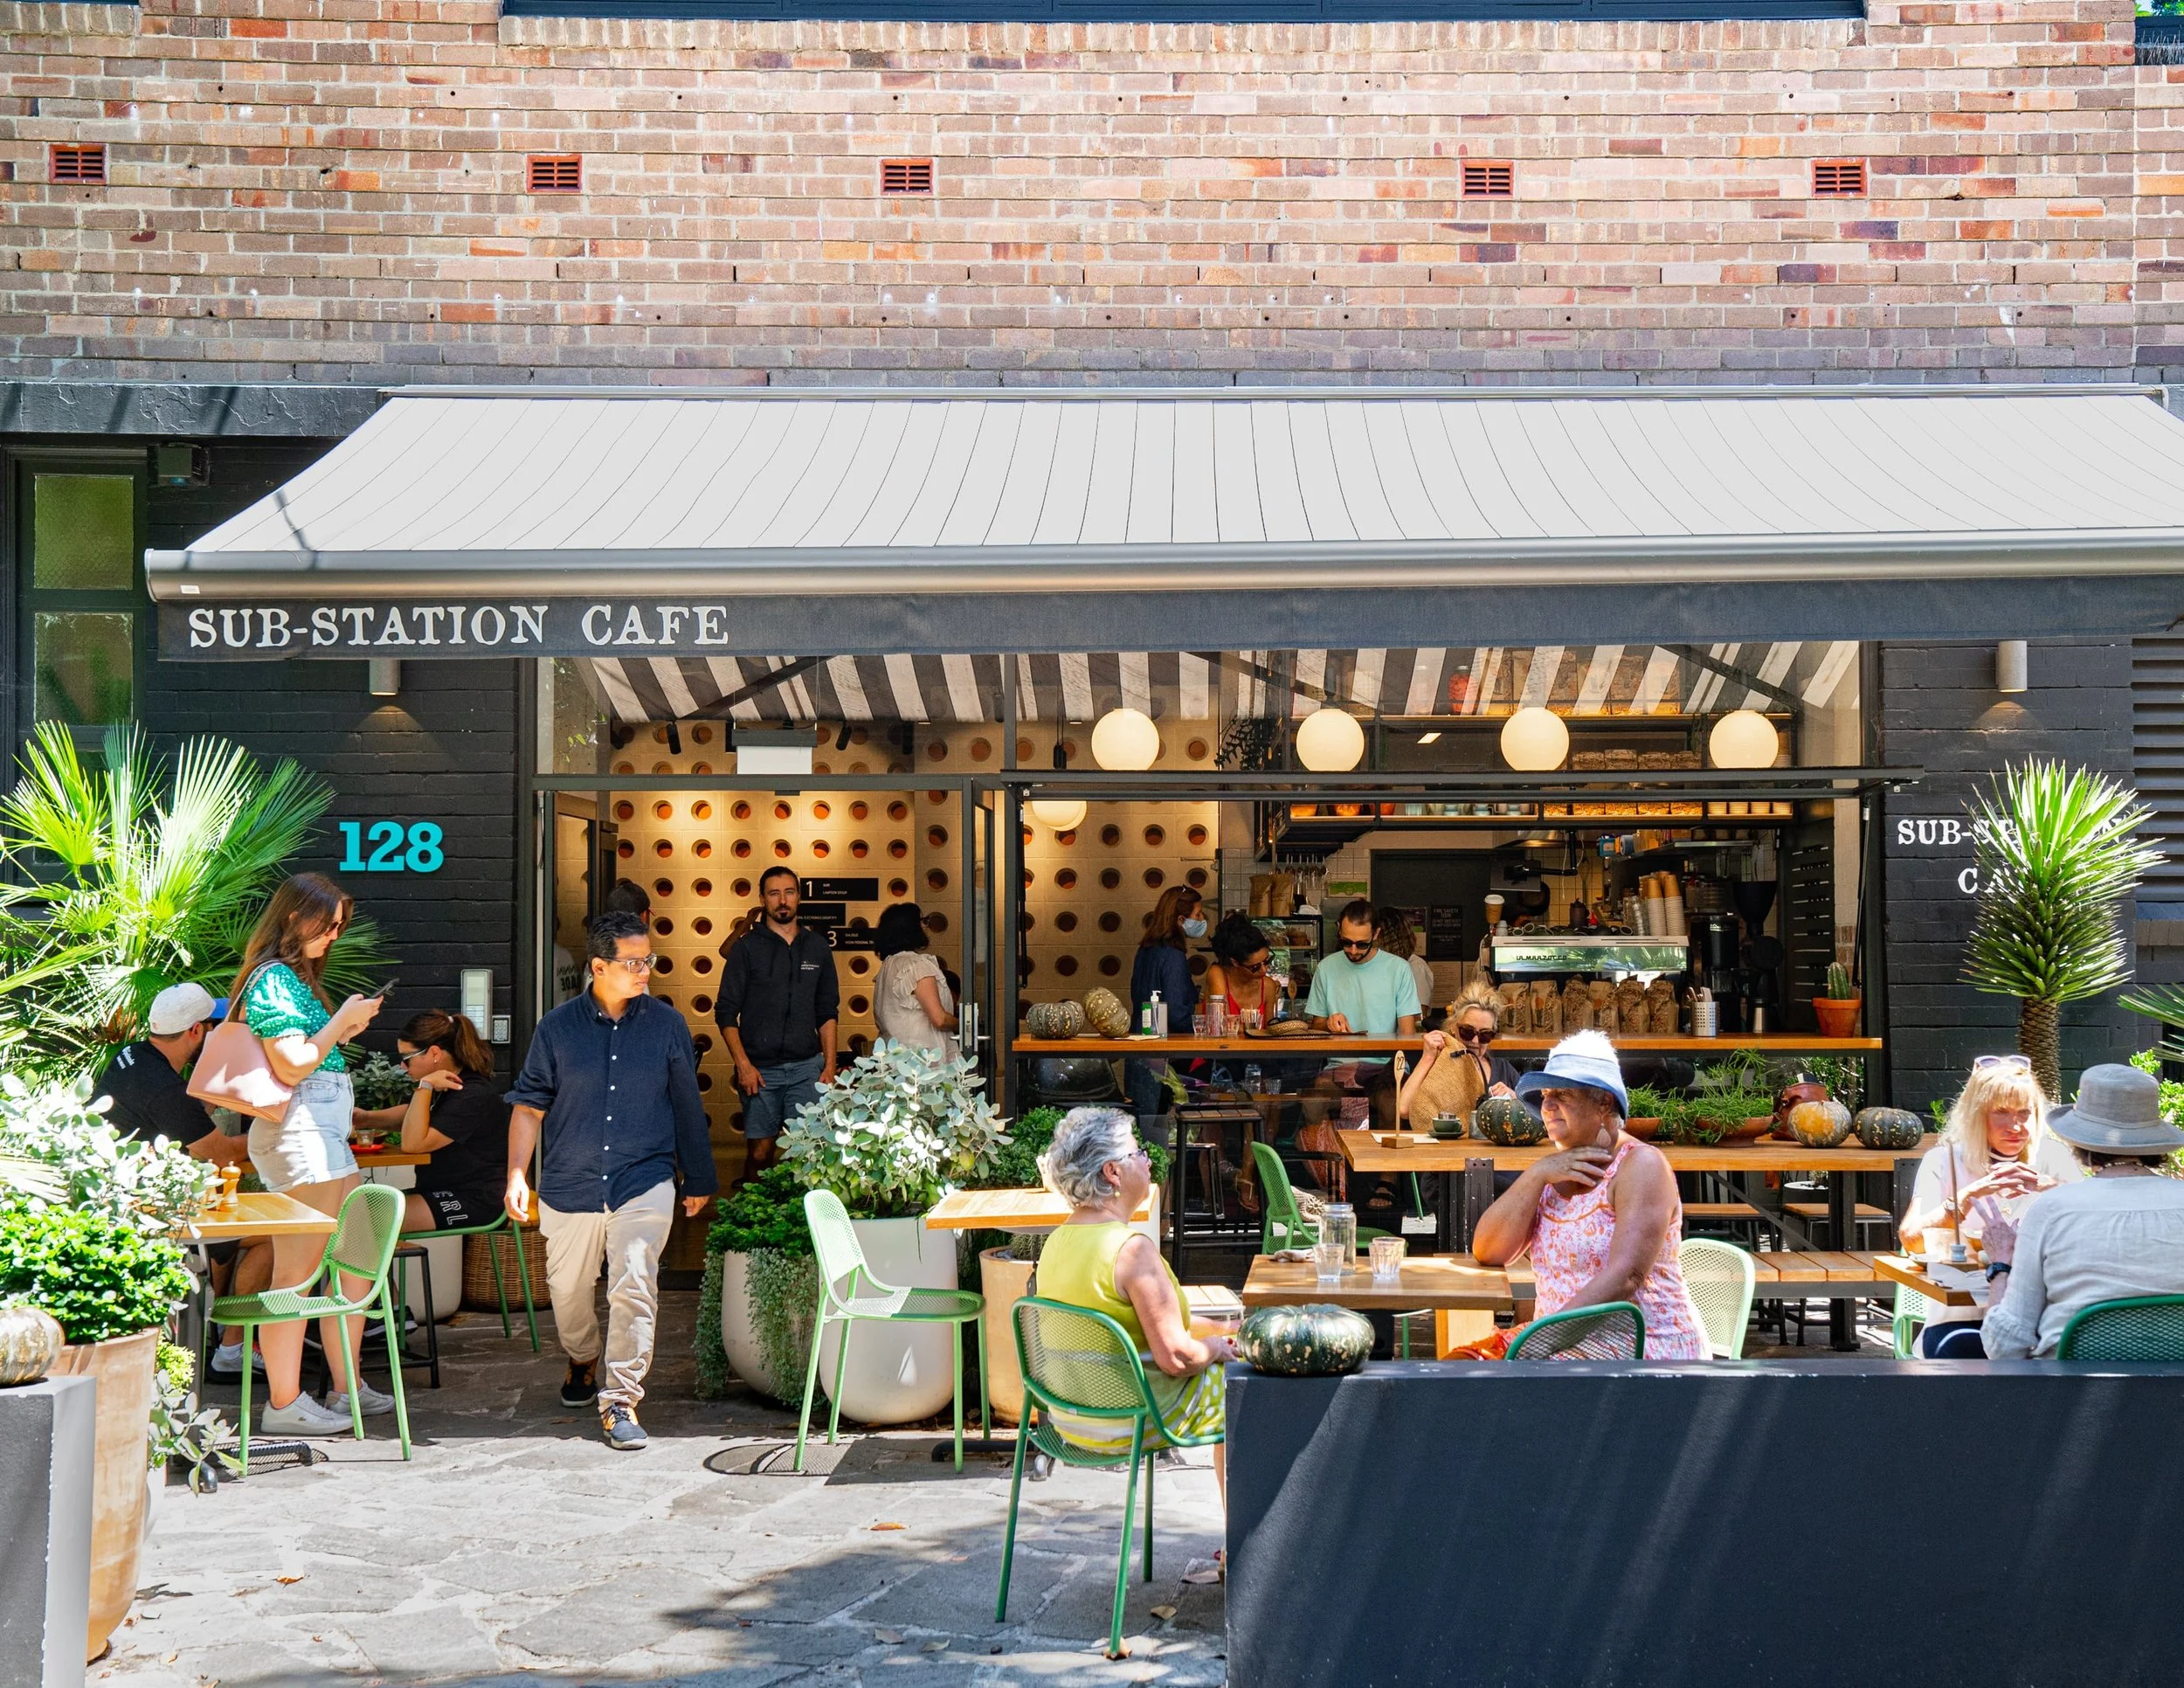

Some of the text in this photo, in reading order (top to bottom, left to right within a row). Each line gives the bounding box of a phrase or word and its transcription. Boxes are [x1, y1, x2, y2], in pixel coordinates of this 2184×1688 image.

[189, 604, 729, 647] SUB-STATION CAFE
[338, 820, 445, 873] 128
[805, 880, 813, 897] 1
[826, 930, 838, 947] 3
[1396, 1055, 1405, 1071] 22
